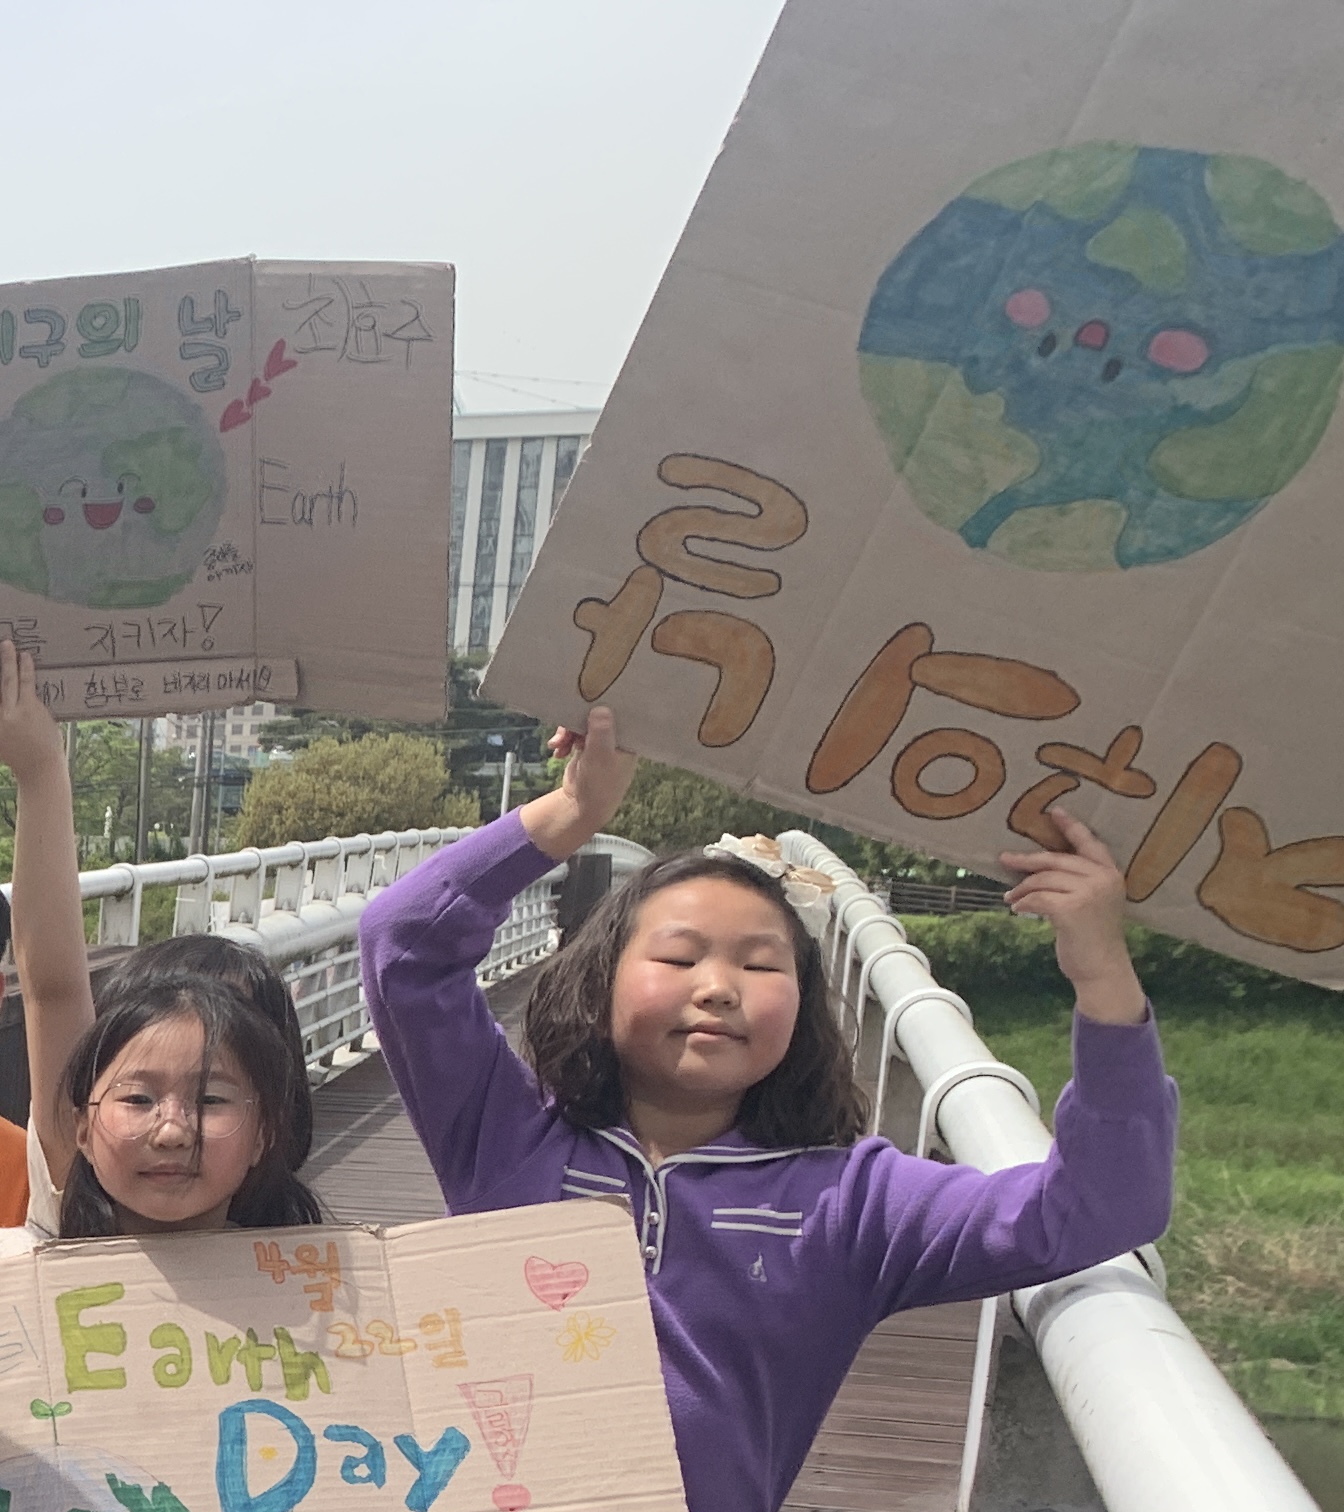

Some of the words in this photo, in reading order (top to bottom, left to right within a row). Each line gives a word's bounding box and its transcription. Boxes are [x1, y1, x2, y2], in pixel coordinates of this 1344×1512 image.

[178, 290, 242, 393] 날
[258, 456, 360, 529] Earth
[253, 1238, 342, 1312] 4월
[55, 1282, 332, 1402] Earth
